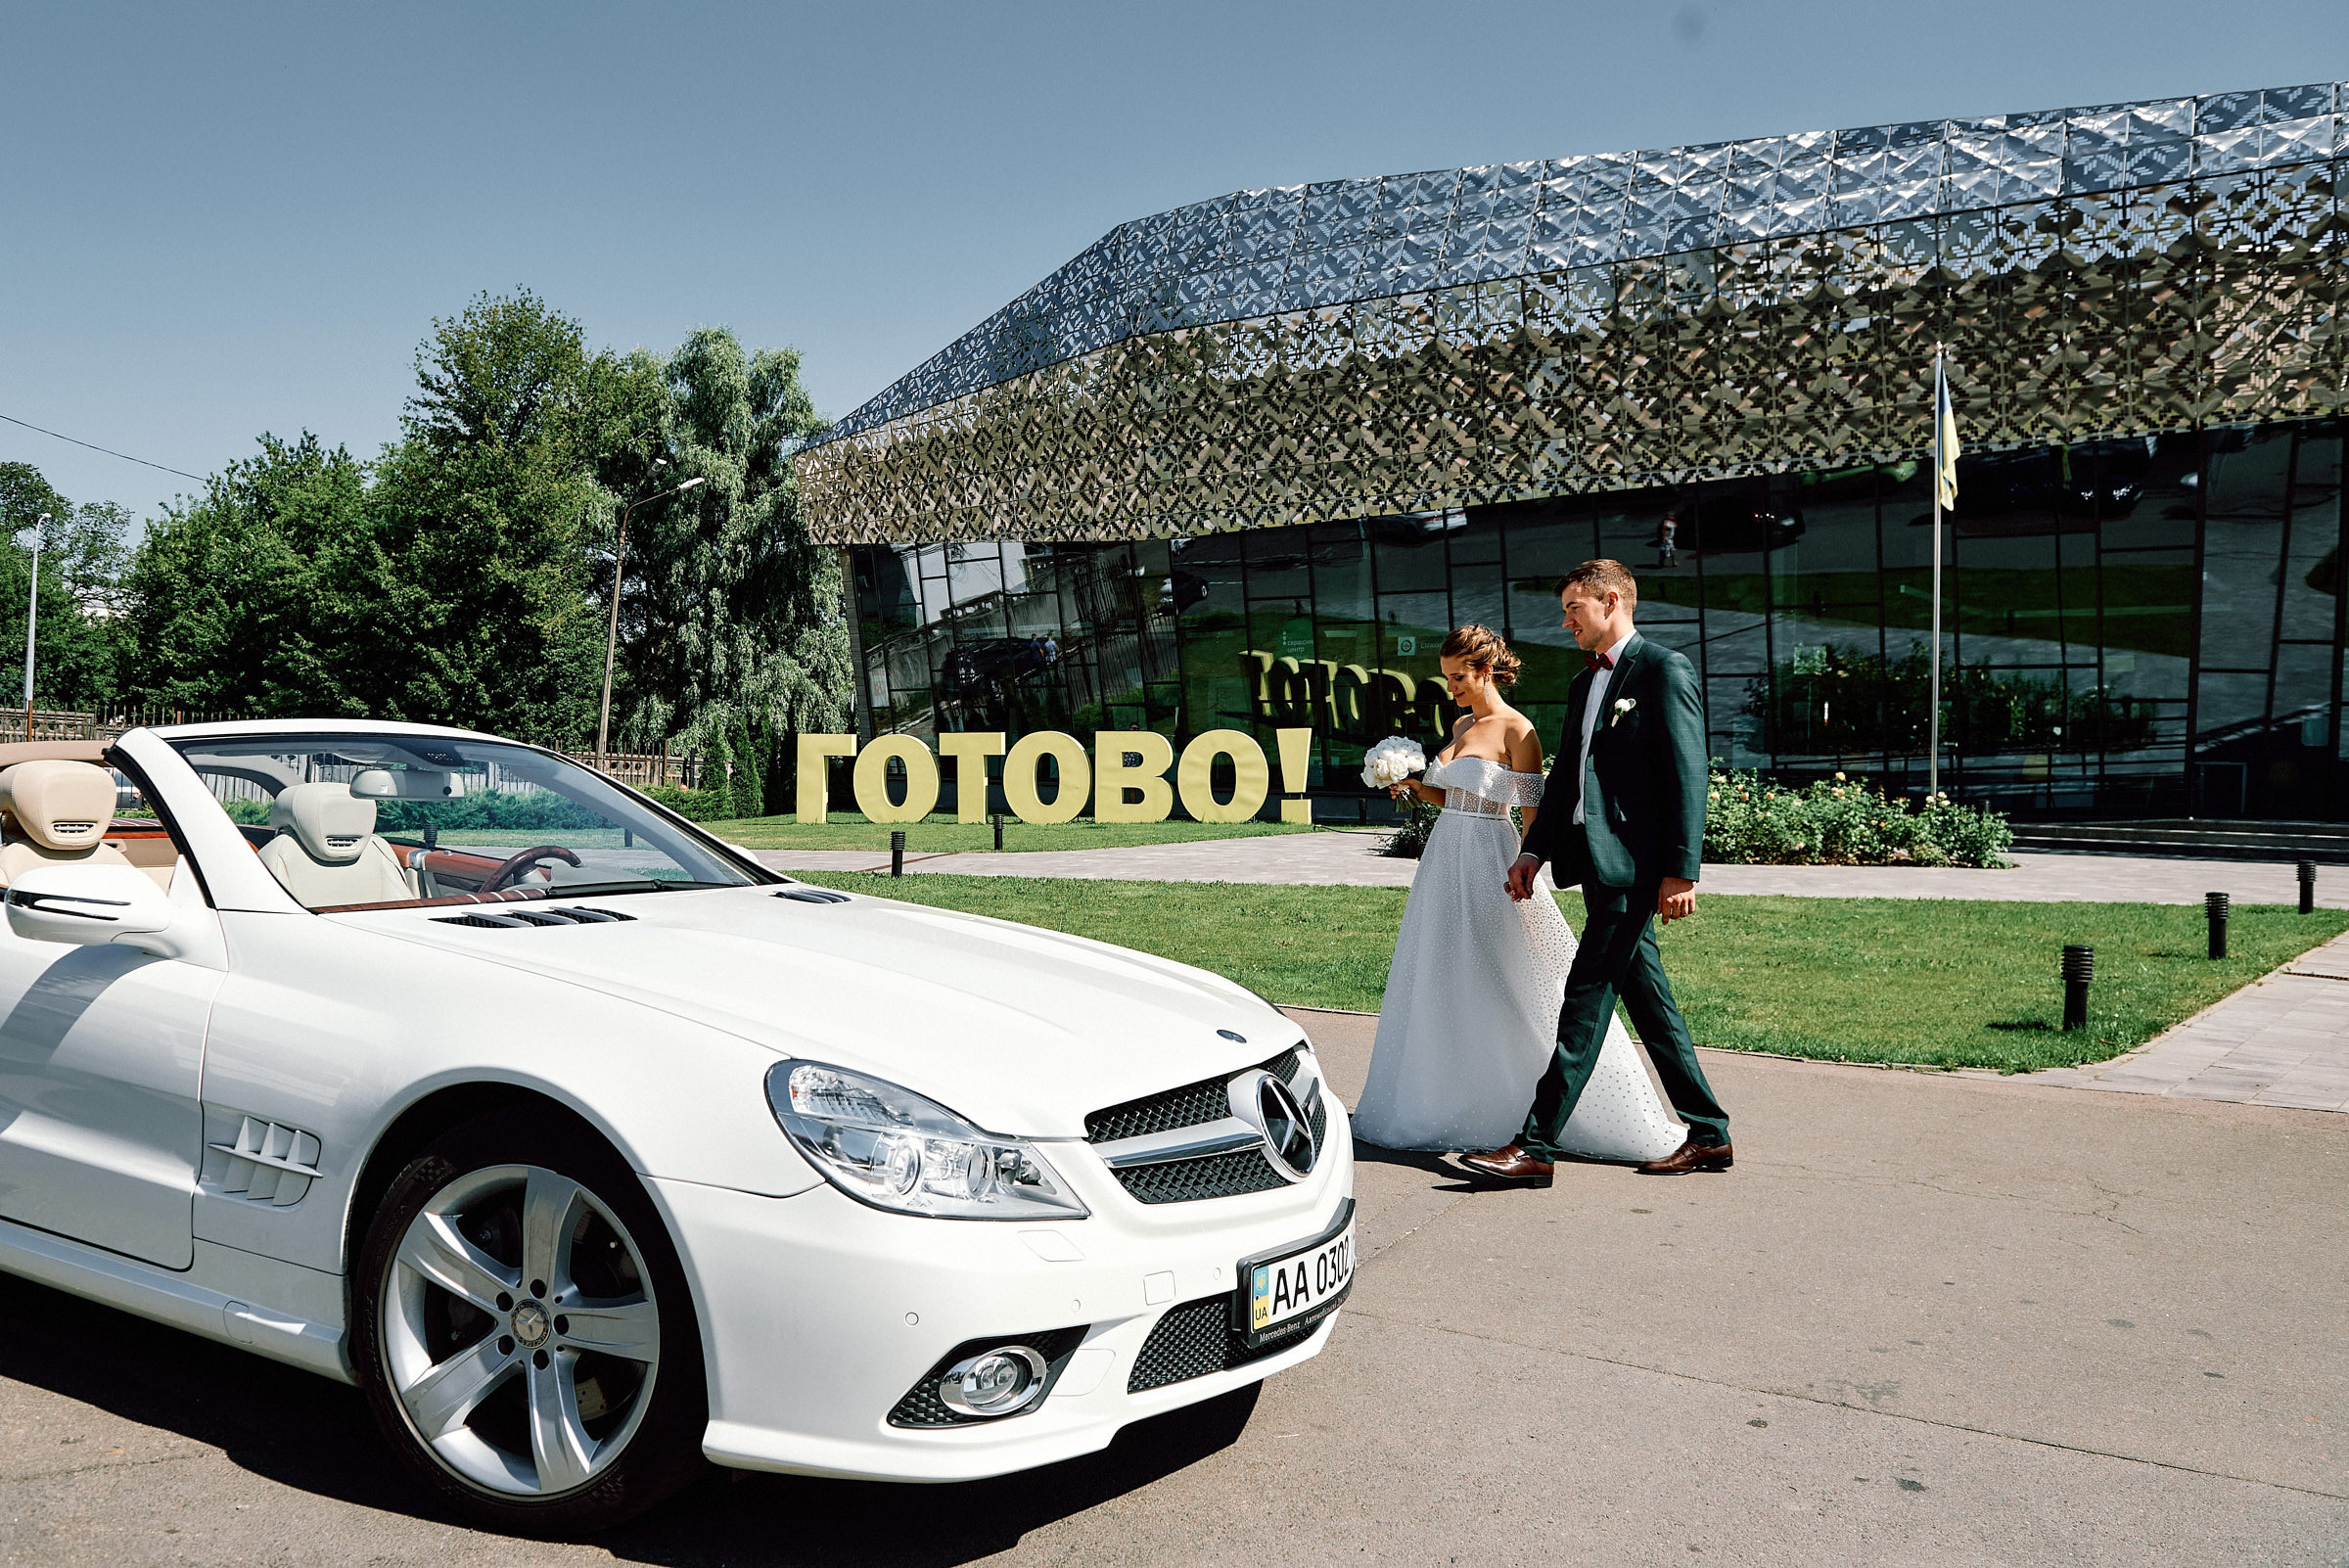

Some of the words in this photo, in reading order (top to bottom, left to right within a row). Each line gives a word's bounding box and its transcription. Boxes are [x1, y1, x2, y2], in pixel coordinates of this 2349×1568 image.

[797, 727, 1313, 825] ГОТОВО!
[1272, 1261, 1310, 1315] AA
[1316, 1234, 1350, 1296] 0302
[1255, 1307, 1268, 1320] UA
[1259, 1321, 1301, 1343] Mercedes-Benz
